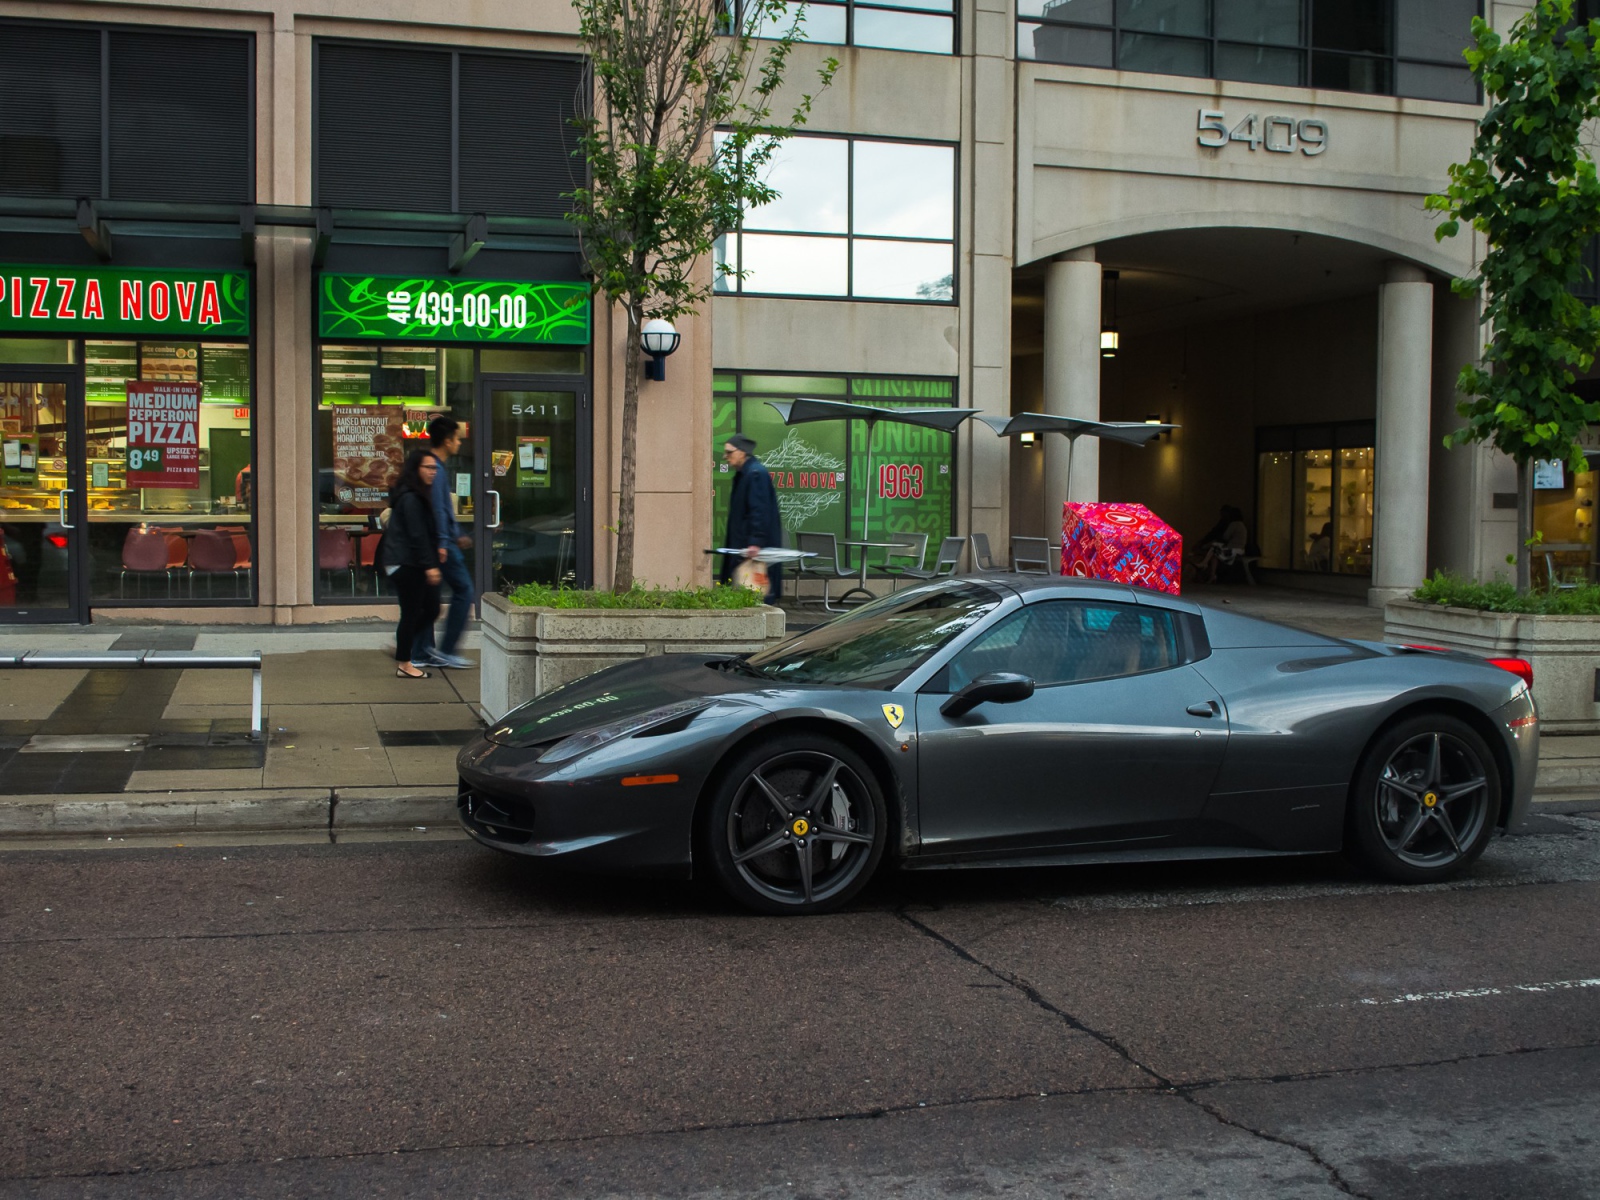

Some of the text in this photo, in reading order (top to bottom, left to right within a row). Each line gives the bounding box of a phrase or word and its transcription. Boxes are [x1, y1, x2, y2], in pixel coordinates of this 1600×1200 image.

[1198, 109, 1329, 156] 5409
[0, 275, 222, 325] IZZA NOVA
[387, 291, 527, 329] 416 439-00-00
[129, 392, 197, 409] MEDIUM
[512, 405, 558, 415] 5411
[129, 408, 197, 422] PEPPERONI
[336, 417, 388, 426] RAISED WITHOUT
[406, 409, 427, 421] free
[129, 421, 197, 444] PIZZA
[336, 426, 386, 435] ANTIBIOTICS OR
[799, 472, 836, 489] NOVA
[879, 464, 924, 499] 1963
[1146, 539, 1166, 562] H1X
[1114, 551, 1134, 572] K4A
[1130, 554, 1154, 584] T9K
